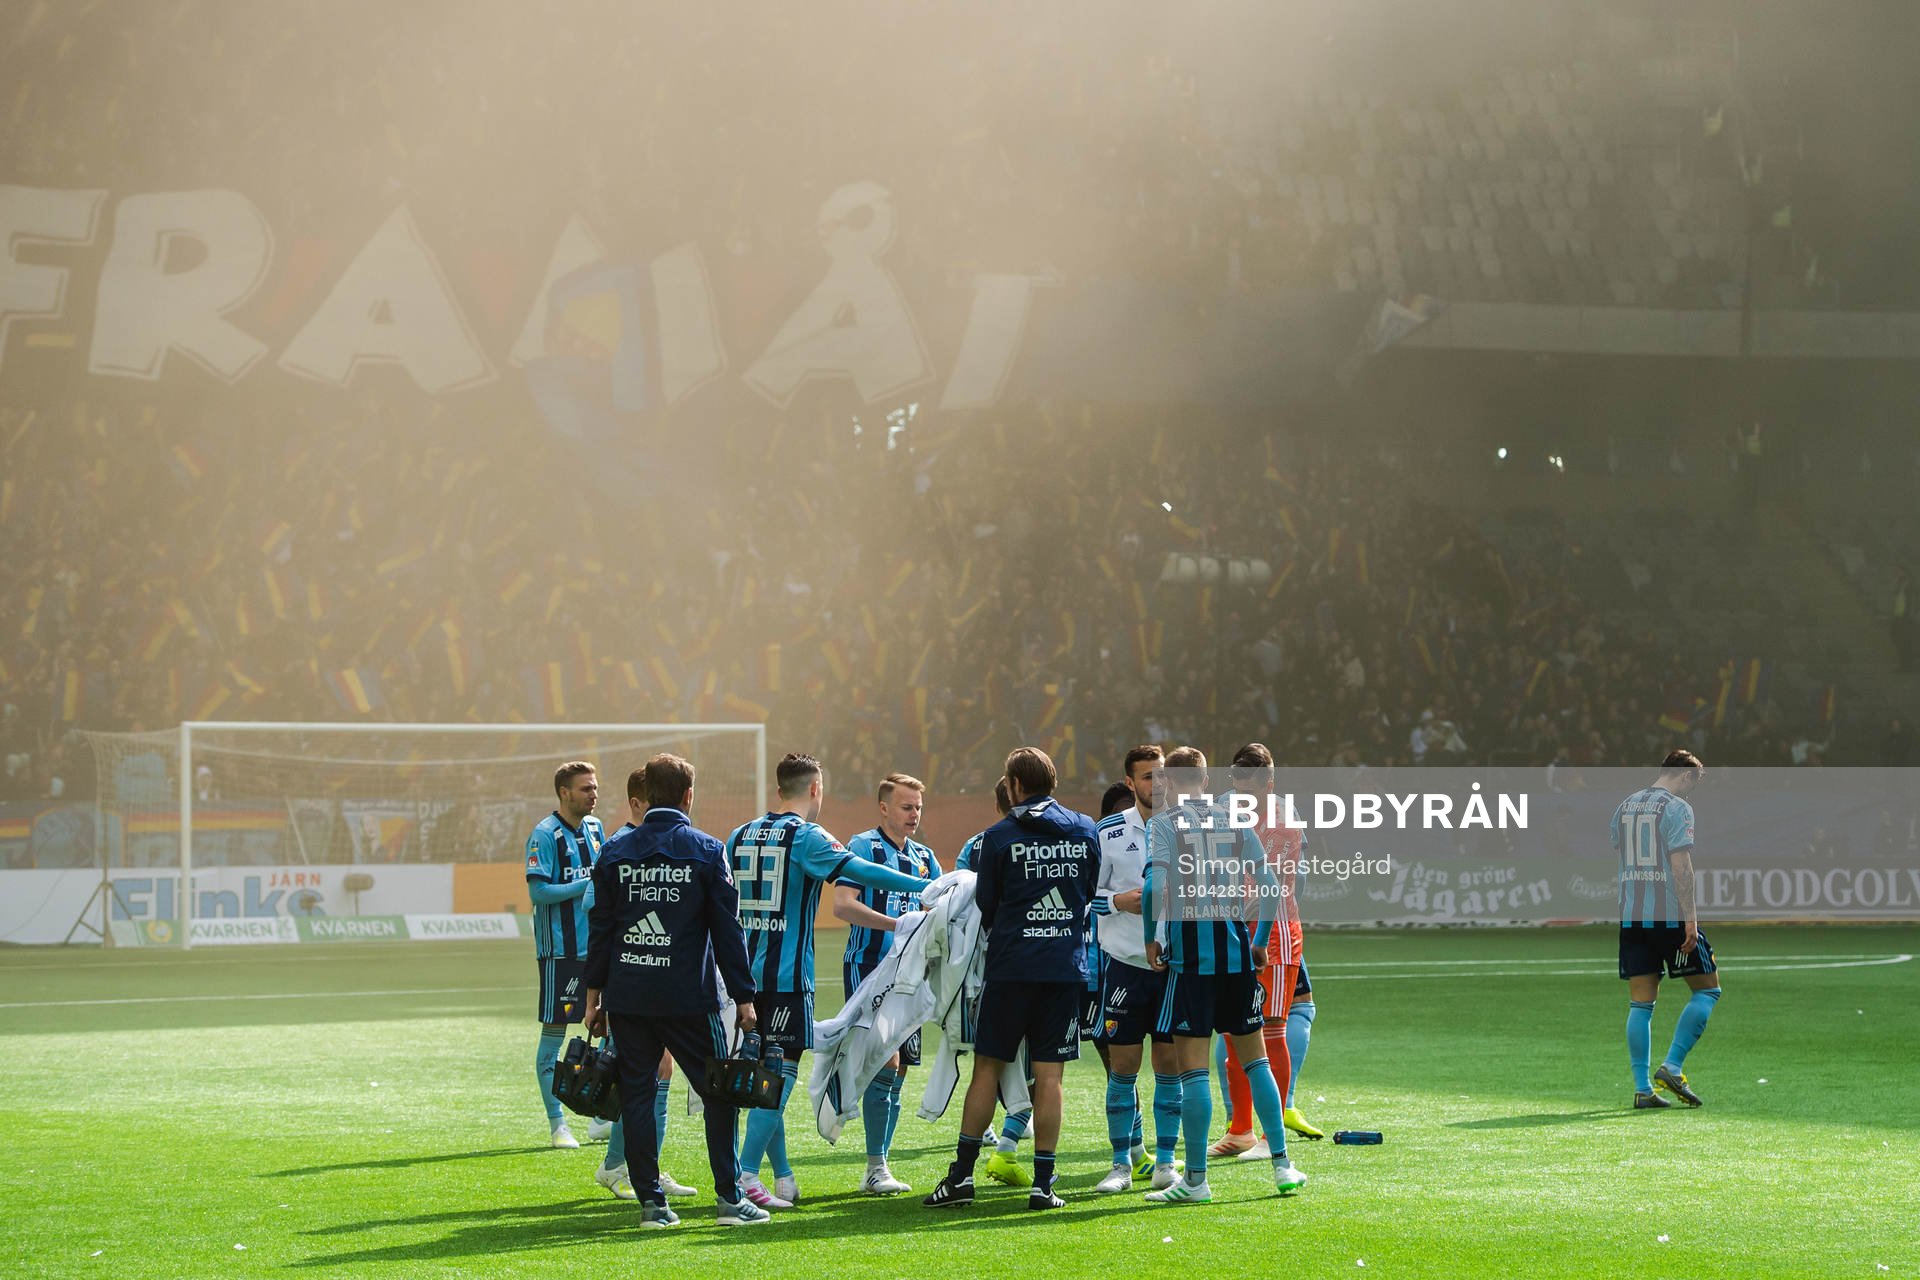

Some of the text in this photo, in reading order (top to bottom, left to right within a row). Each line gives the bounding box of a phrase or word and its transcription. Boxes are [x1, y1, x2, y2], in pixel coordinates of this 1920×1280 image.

[741, 828, 786, 841] ULVESTAD
[1107, 828, 1125, 840] ABT
[1621, 814, 1658, 867] 10
[1010, 839, 1089, 863] Prioritet
[732, 845, 787, 912] 23
[1024, 860, 1079, 880] Finans
[1026, 908, 1073, 921] adidas
[310, 919, 397, 937] KVARNEN
[420, 918, 504, 935] KVARNEN
[623, 932, 671, 946] adidas
[619, 951, 671, 967] stadium
